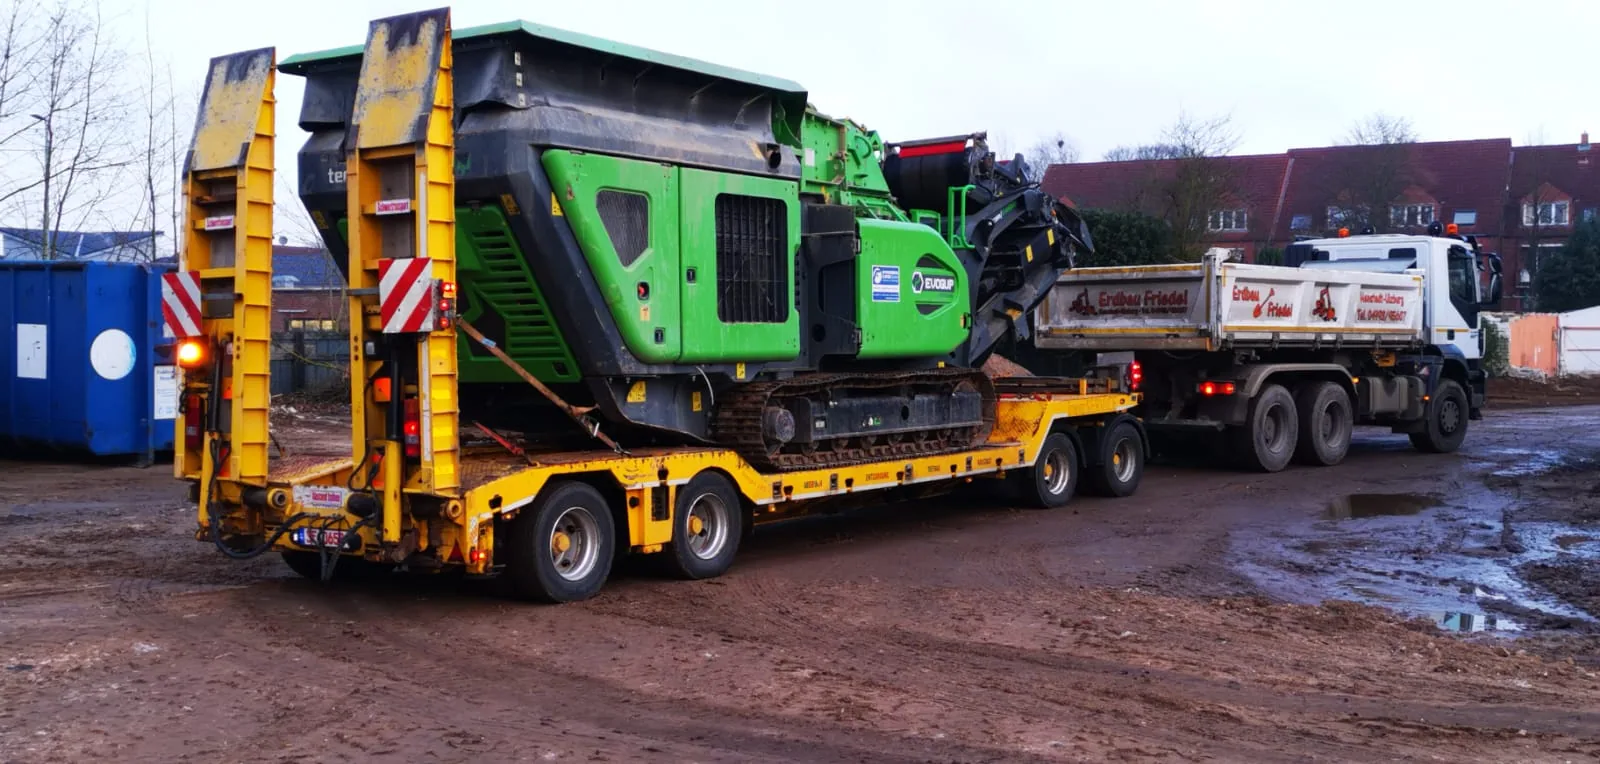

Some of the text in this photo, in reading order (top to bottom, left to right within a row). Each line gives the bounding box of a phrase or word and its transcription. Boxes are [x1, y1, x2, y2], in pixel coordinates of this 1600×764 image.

[1098, 288, 1188, 307] Erdbau Friedel
[1232, 285, 1260, 301] Erdbau
[1267, 302, 1293, 317] Friedel
